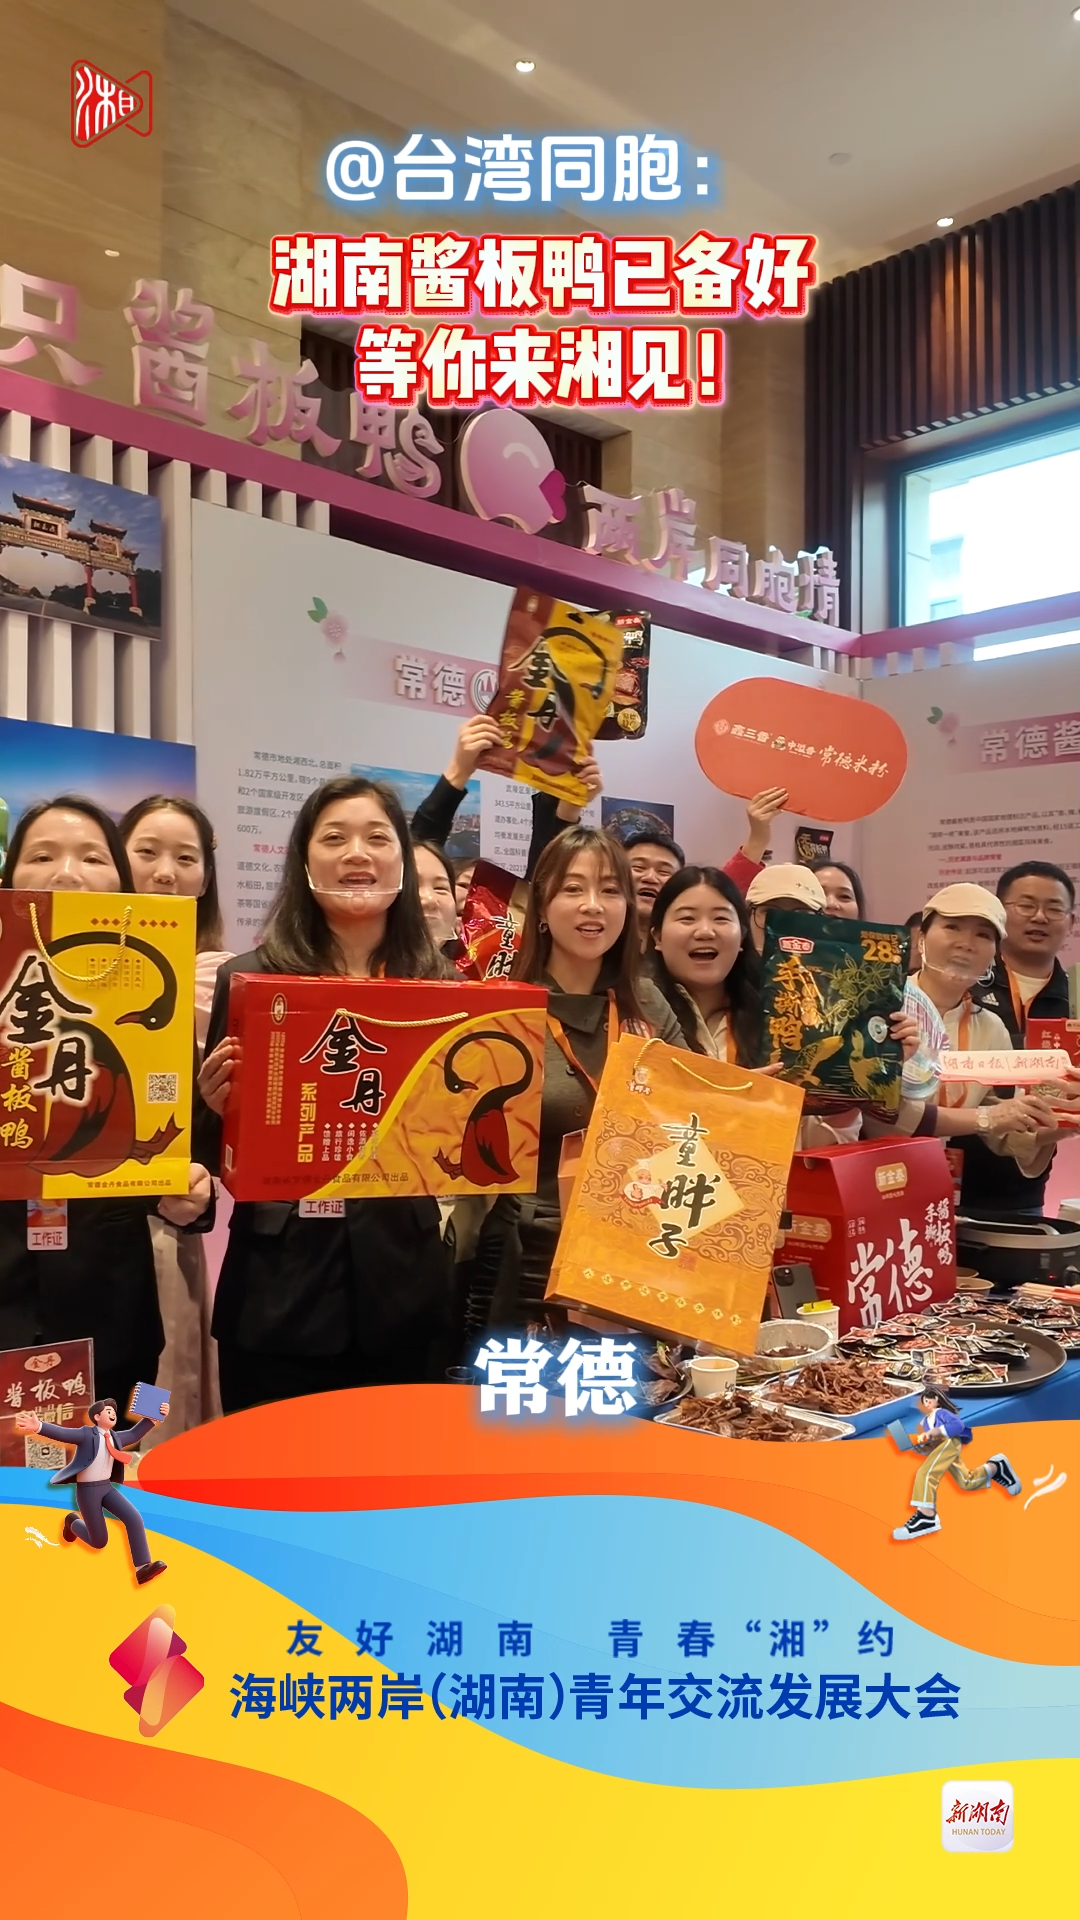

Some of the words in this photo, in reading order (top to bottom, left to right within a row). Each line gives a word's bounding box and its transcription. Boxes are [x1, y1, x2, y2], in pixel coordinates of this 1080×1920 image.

[574, 482, 841, 627] 两岸同胞情
[818, 744, 889, 778] 常德米粉
[861, 939, 894, 963] 28
[300, 1008, 388, 1116] 金丹
[0, 1045, 38, 1150] 酱板鸭
[297, 1082, 318, 1163] 系列产品
[647, 1112, 722, 1259] 童胖子
[877, 1167, 906, 1187] 新金泰
[304, 1200, 344, 1214] 工作证
[32, 1230, 63, 1247] 工作证
[846, 1217, 934, 1327] 常德
[3, 1371, 87, 1409] 酱板鸭
